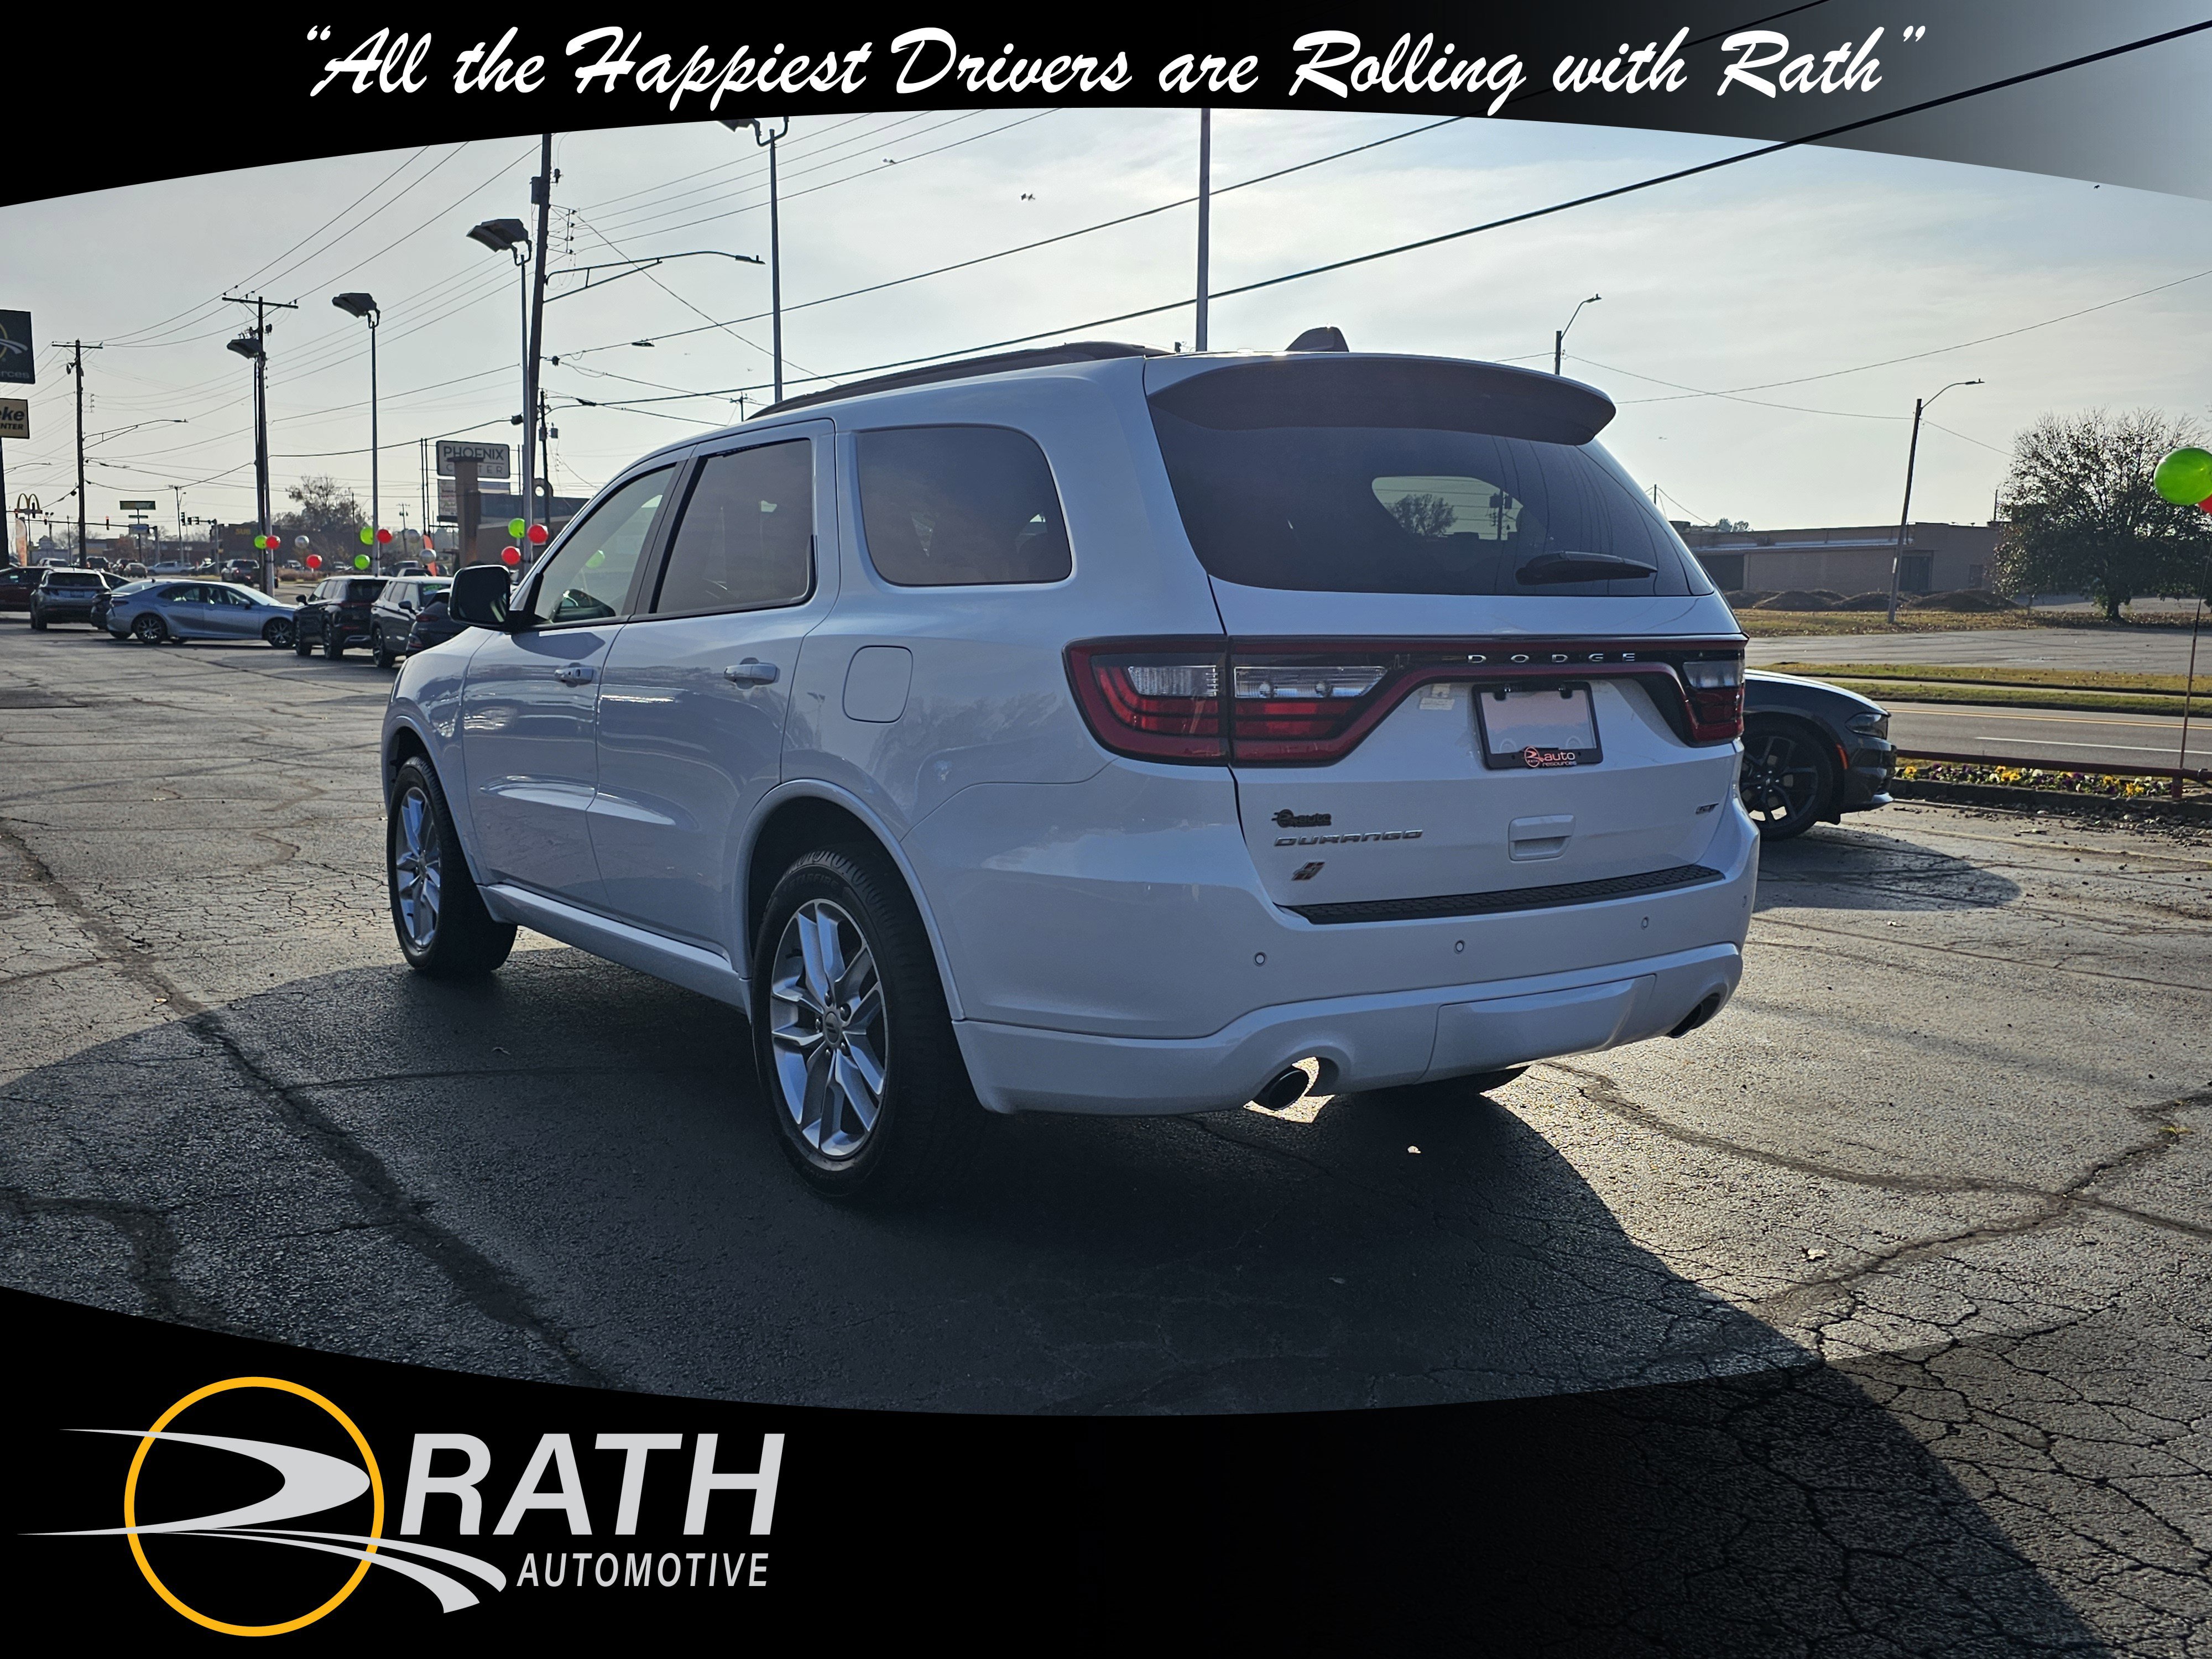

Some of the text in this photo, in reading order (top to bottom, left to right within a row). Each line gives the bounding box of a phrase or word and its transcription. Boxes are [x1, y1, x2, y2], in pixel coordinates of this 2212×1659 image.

[0, 371, 30, 379] rces
[0, 406, 25, 421] ke
[444, 446, 504, 461] PHOENIX
[446, 463, 503, 474] CTER
[1468, 654, 1635, 663] DODGE
[1544, 752, 1575, 761] auto
[1274, 830, 1423, 847] DURANGO
